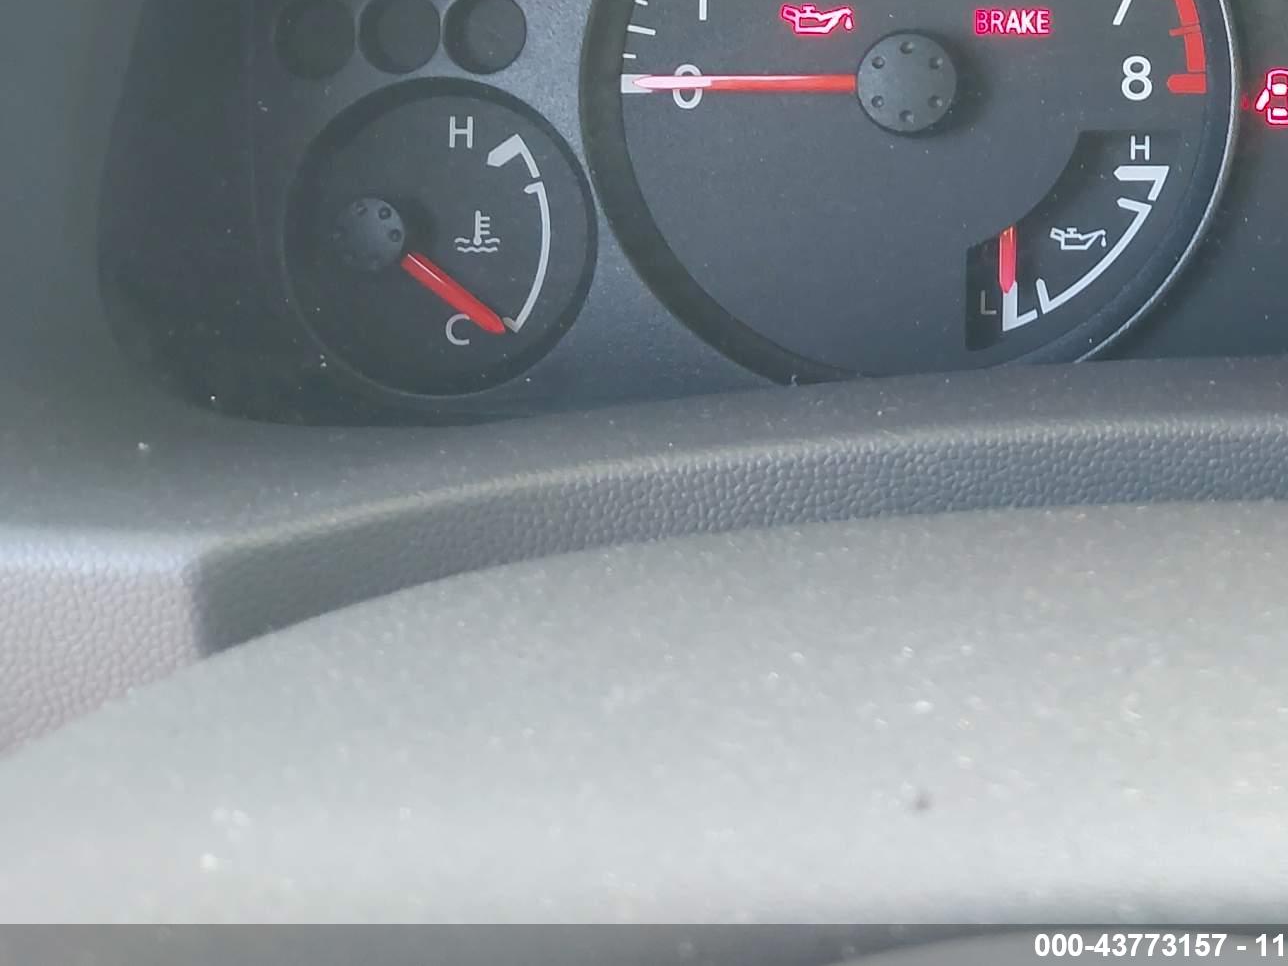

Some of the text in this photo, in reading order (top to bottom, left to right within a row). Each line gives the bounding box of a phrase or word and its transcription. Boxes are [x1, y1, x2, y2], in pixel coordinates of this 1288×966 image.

[975, 9, 1051, 35] BRAKE
[672, 64, 702, 109] 0
[1121, 56, 1153, 101] 8
[449, 116, 473, 148] H
[1131, 135, 1150, 161] H
[981, 290, 997, 315] L
[445, 314, 470, 346] C
